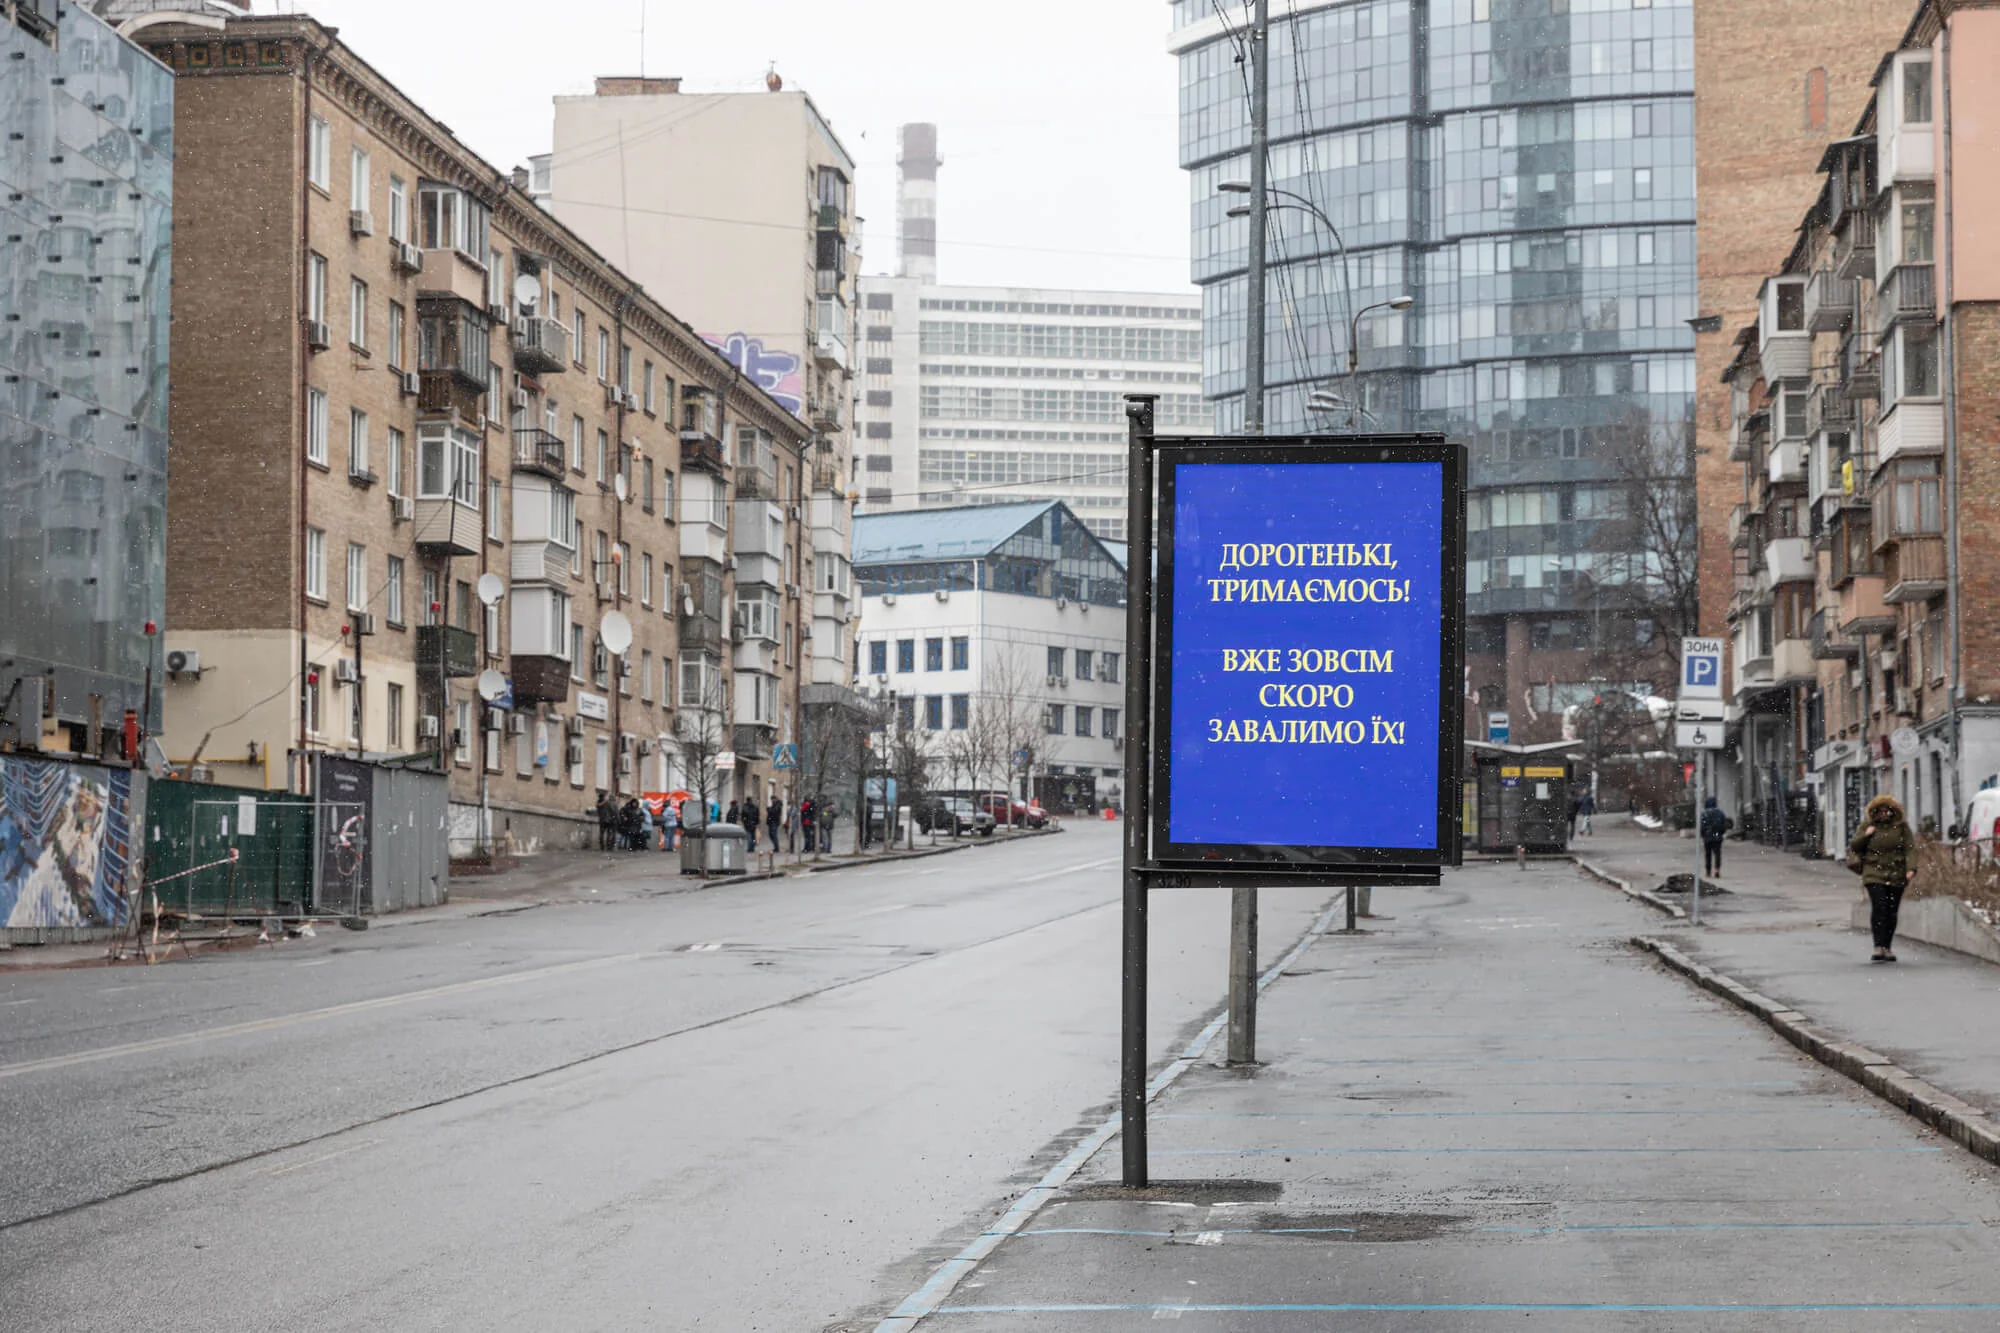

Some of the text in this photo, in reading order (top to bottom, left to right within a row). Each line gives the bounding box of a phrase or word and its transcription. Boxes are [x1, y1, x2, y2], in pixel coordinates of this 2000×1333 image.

[1219, 543, 1398, 571] ДОРОГЕНЬКІ,
[1207, 578, 1410, 602] ТРИМАЄМОСЬ!
[1686, 641, 1719, 652] ЗОНА
[1222, 648, 1394, 673] ВЖЕ ЗОВСІМ
[1694, 658, 1712, 683] P
[1259, 683, 1354, 708] СКОРО
[1207, 715, 1405, 745] ЗАВАЛИМО ЇХ!
